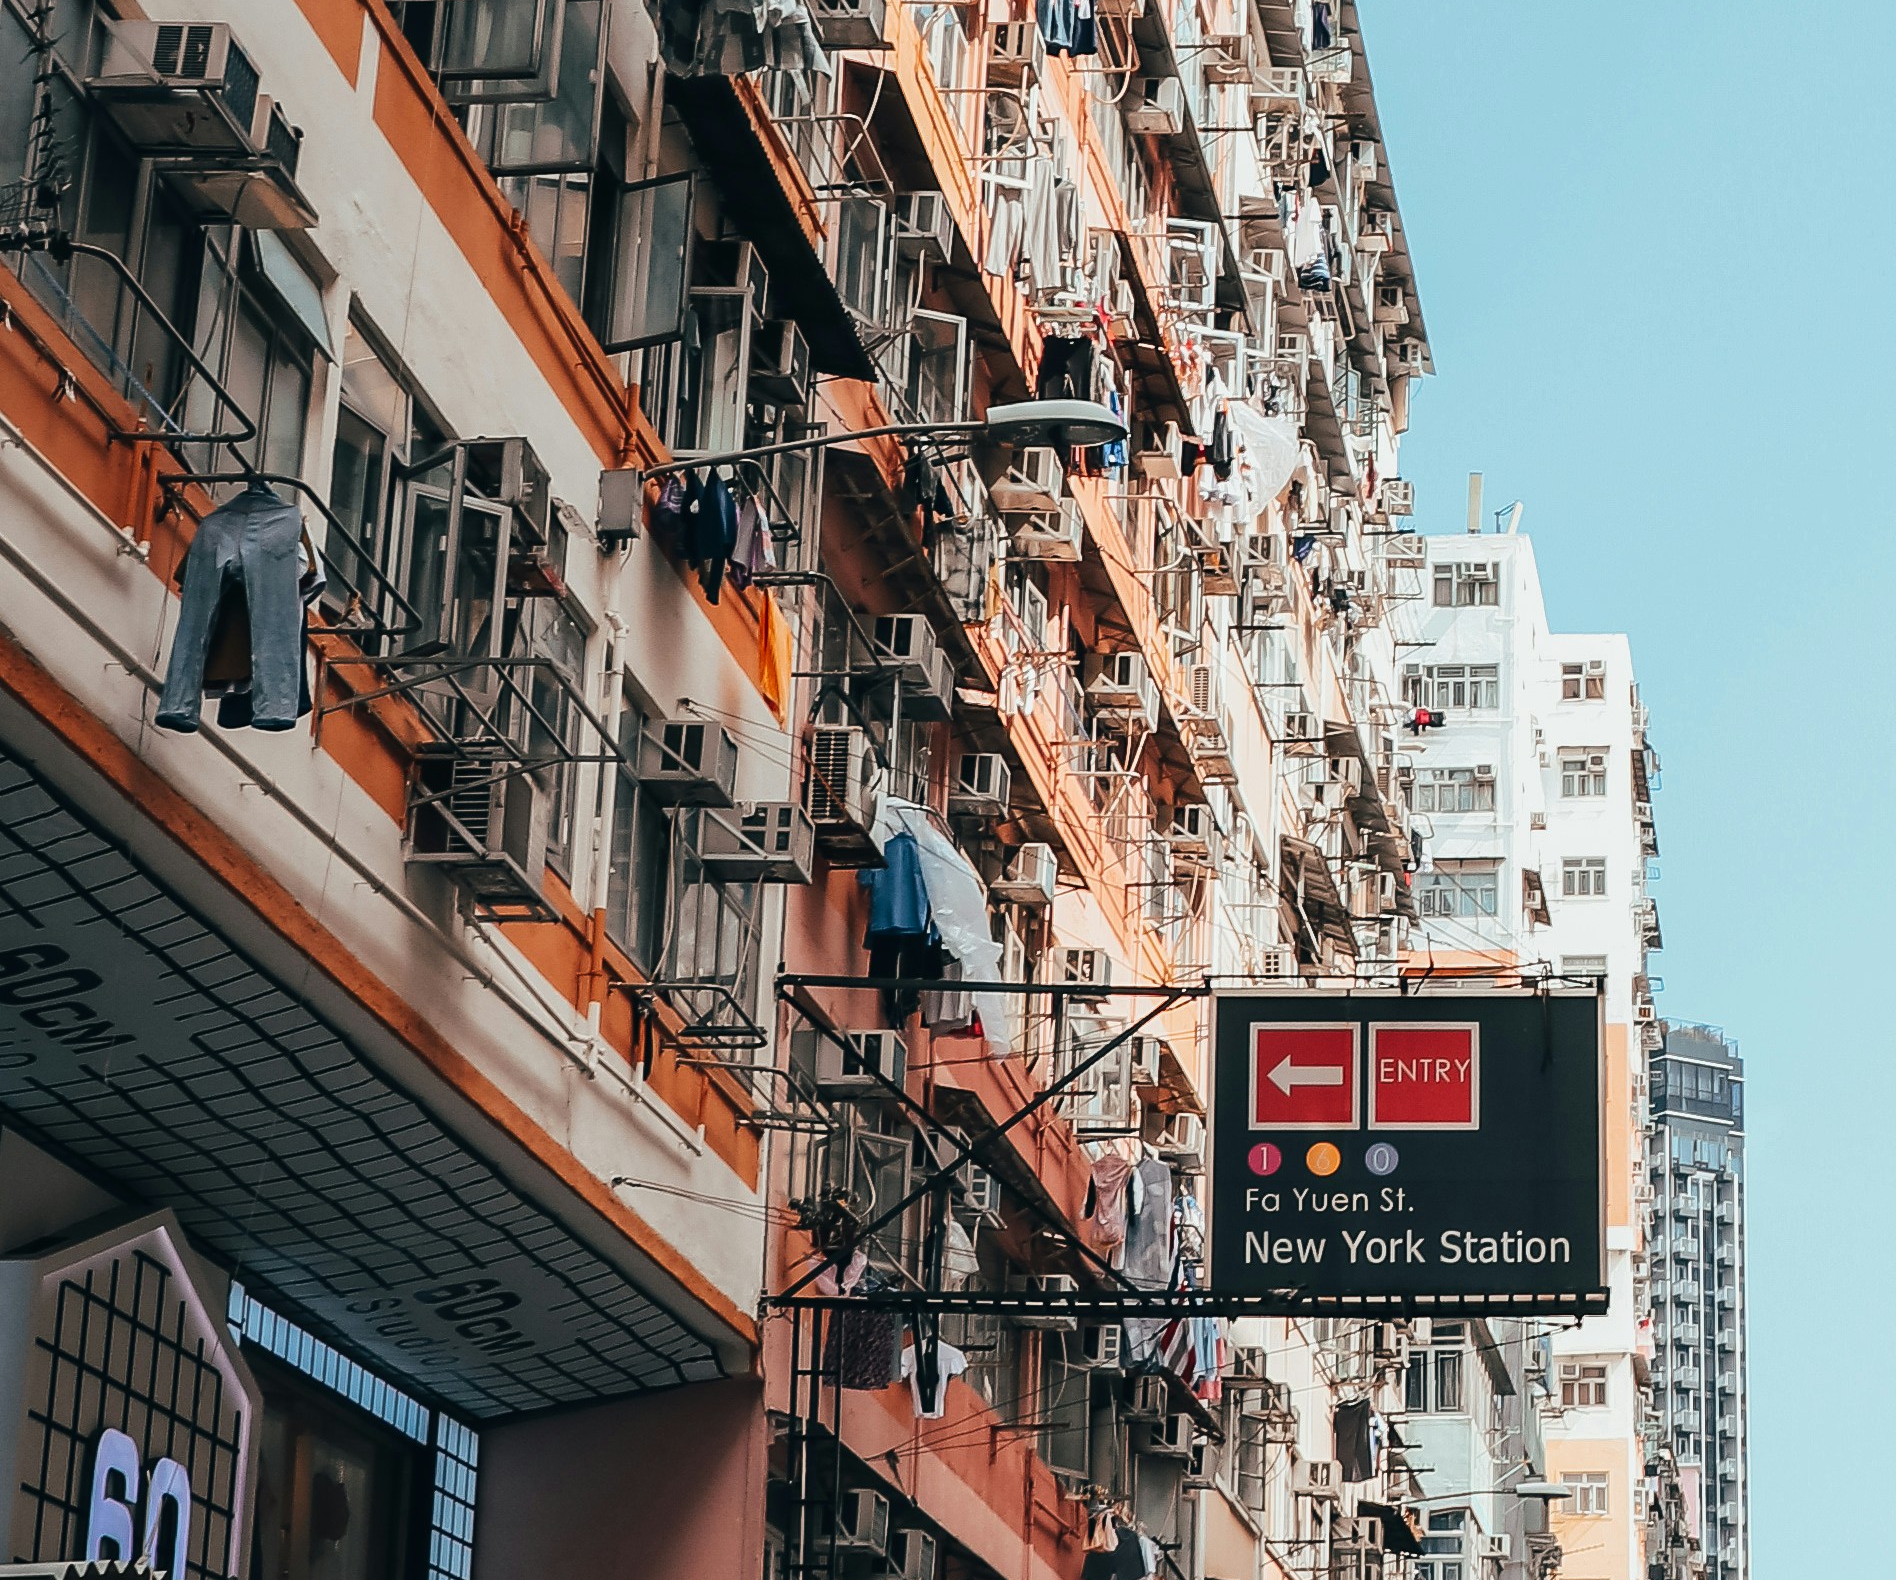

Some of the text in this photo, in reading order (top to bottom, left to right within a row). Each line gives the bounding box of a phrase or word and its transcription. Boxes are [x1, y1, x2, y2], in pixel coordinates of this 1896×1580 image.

[1379, 1057, 1472, 1084] ENTRY
[1245, 1186, 1415, 1213] Fa Yuen St.
[1244, 1228, 1571, 1265] New York Station
[345, 1296, 461, 1367] Studio
